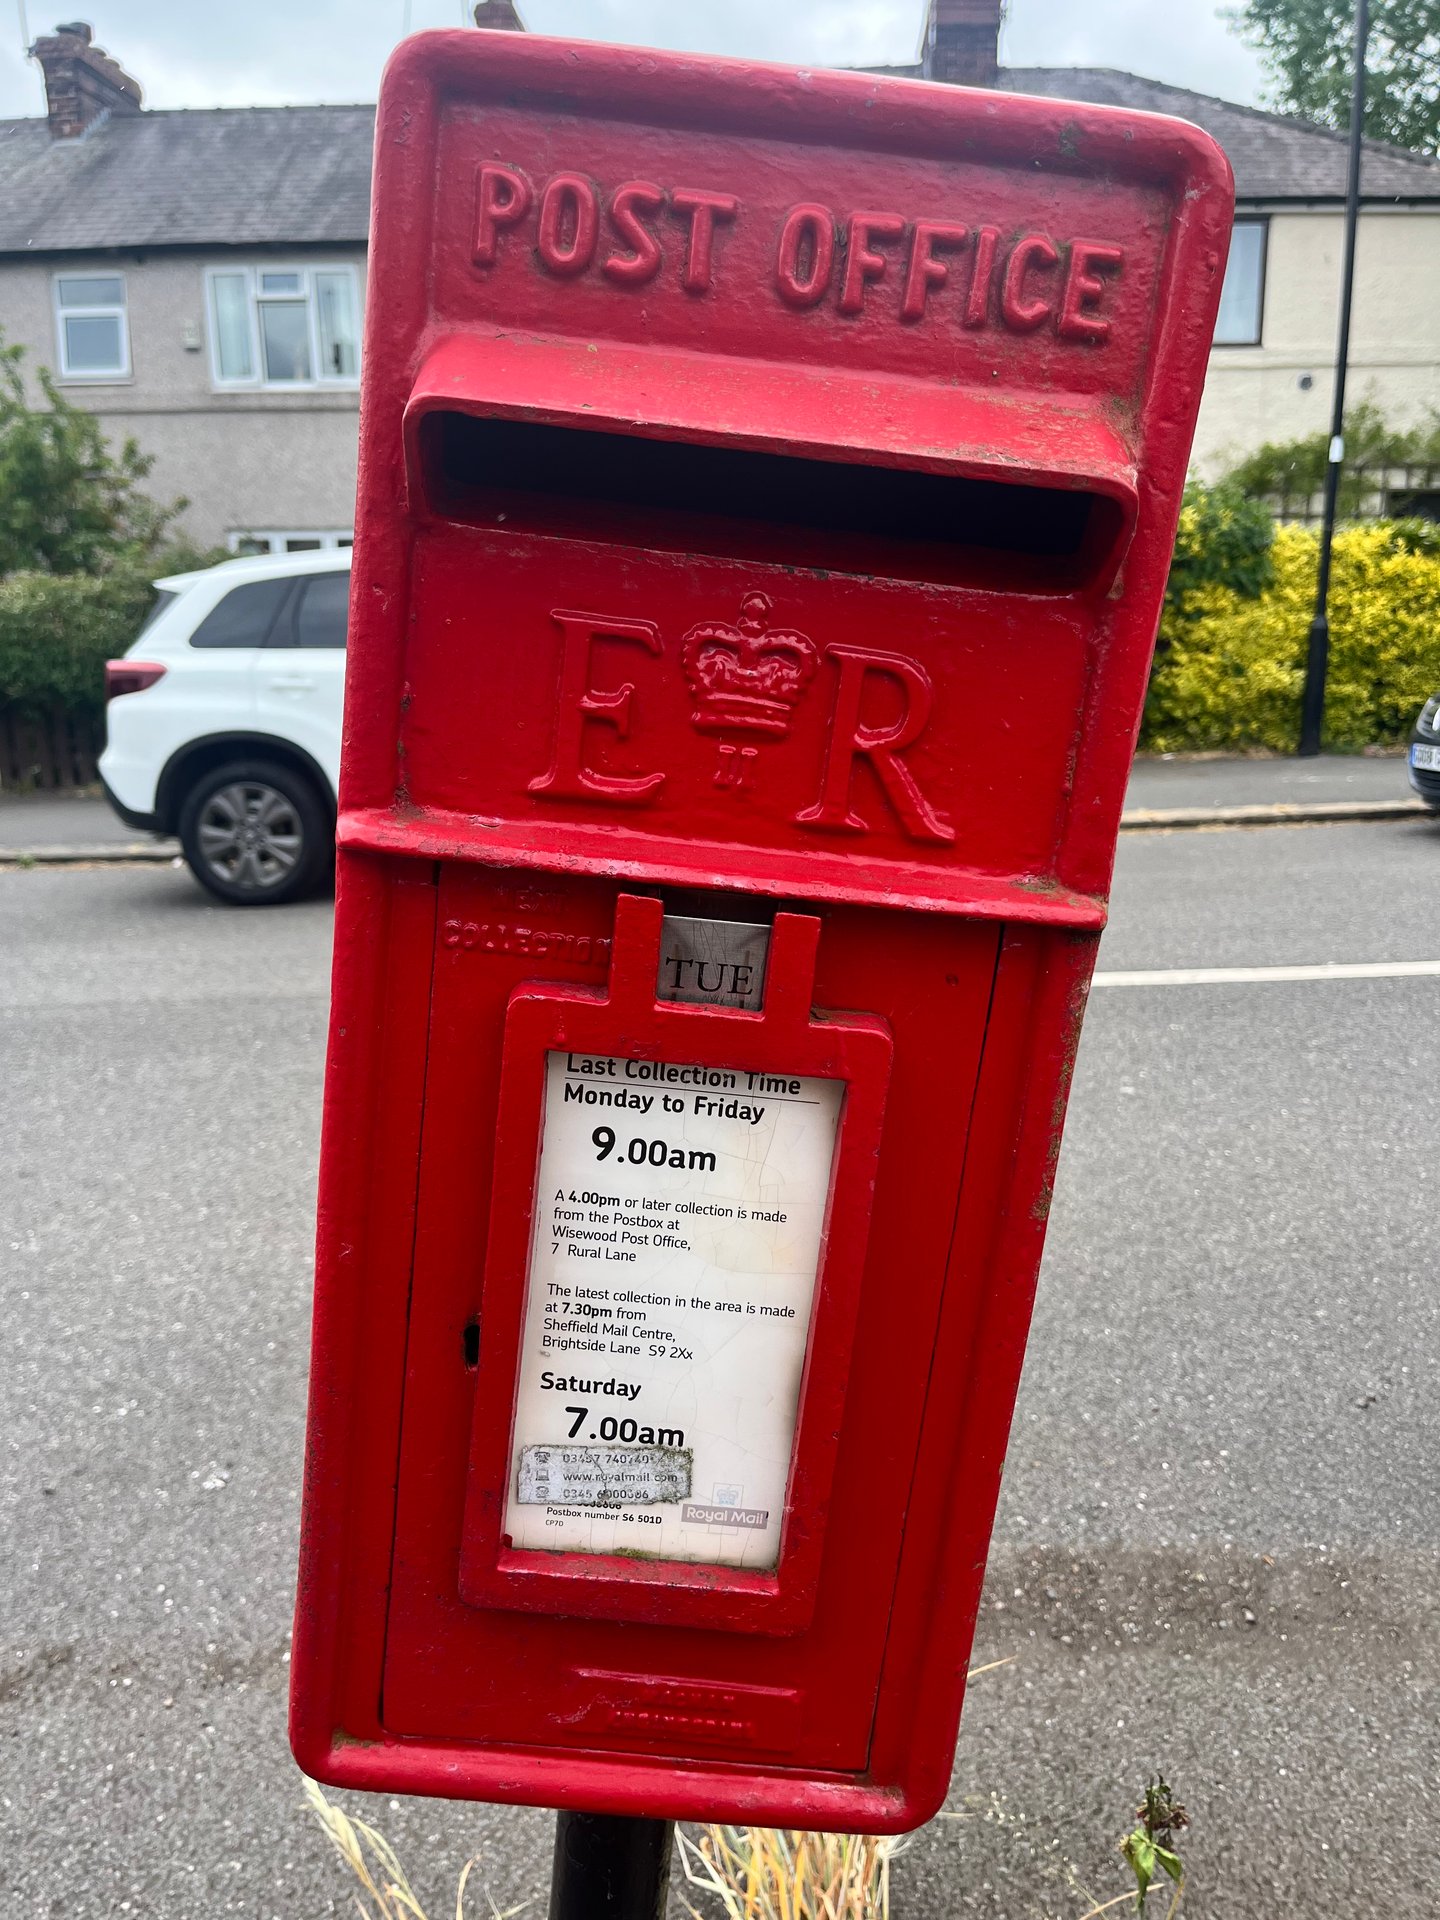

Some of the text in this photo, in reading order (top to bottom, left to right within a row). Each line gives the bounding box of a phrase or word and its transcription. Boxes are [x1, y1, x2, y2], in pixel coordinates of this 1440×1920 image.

[470, 159, 1124, 340] POST OFFICE
[527, 608, 957, 844] E R
[665, 957, 754, 997] TUE
[567, 1054, 800, 1094] Last Collection Time
[564, 1083, 765, 1125] Monday to Friday
[592, 1126, 716, 1172] 9.00am
[554, 1207, 680, 1230] from the Postbox at
[555, 1189, 787, 1223] A 4.00pm or later collection is made
[552, 1224, 690, 1251] Wisewood Post Office,
[552, 1242, 636, 1262] 7 Rural Lane
[545, 1302, 646, 1321] at 7.30pm from
[547, 1283, 795, 1318] The latest collection in the area is made
[544, 1318, 675, 1343] Sheffield Mail Centre,
[543, 1335, 606, 1352] Brightside
[610, 1341, 640, 1355] Lane
[649, 1345, 666, 1357] S9
[540, 1372, 641, 1401] Saturday
[564, 1406, 684, 1447] 7.00am
[563, 1473, 677, 1483] www.royalmailcom
[563, 1489, 592, 1498] 0345
[547, 1507, 662, 1524] Postbox number S6 501D
[686, 1506, 764, 1524] Royal Mail
